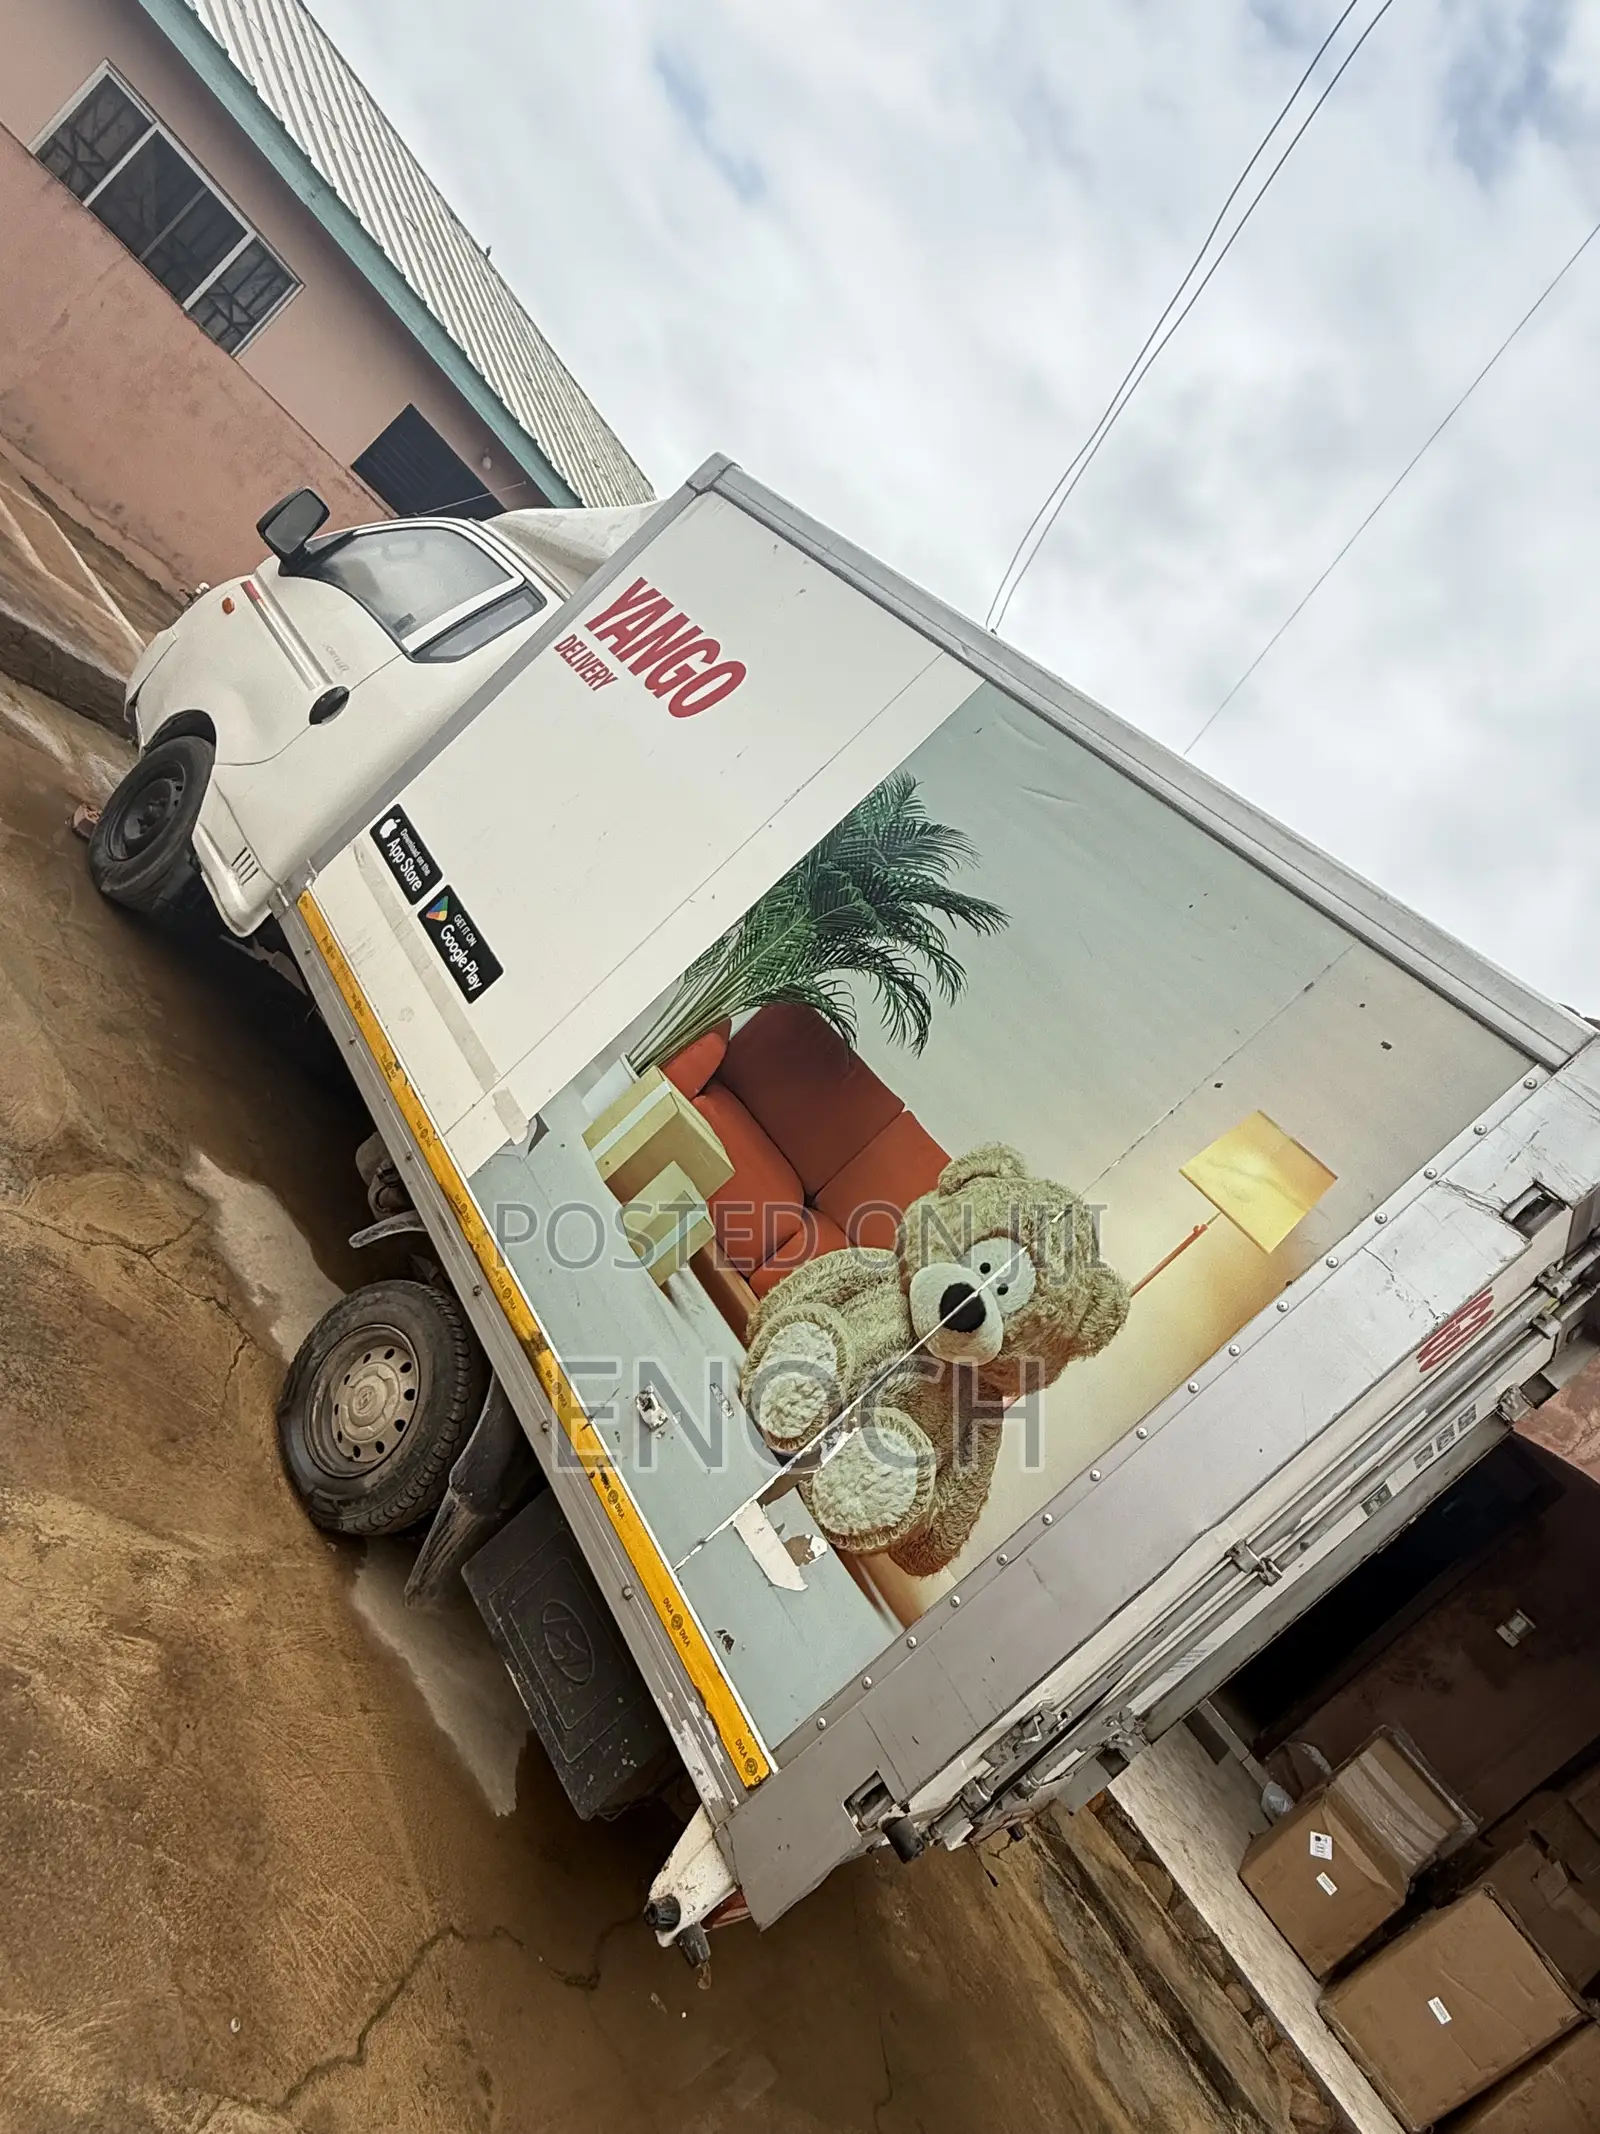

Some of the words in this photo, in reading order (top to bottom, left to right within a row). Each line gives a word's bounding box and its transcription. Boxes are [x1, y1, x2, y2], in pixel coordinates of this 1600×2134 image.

[554, 634, 618, 691] DELIVERY
[584, 577, 747, 718] YANGO
[387, 837, 406, 864] App
[400, 857, 423, 892] Store
[400, 828, 421, 858] Download
[416, 856, 425, 866] on
[421, 863, 431, 876] the
[454, 914, 467, 930] GET
[461, 926, 471, 936] IT
[466, 933, 478, 947] ON
[441, 924, 469, 968] Google
[462, 960, 483, 992] Play
[614, 1502, 625, 1520] DVLA
[663, 1597, 675, 1616] DVLA
[679, 1629, 691, 1648] DVLA
[735, 1738, 748, 1759] DVLA
